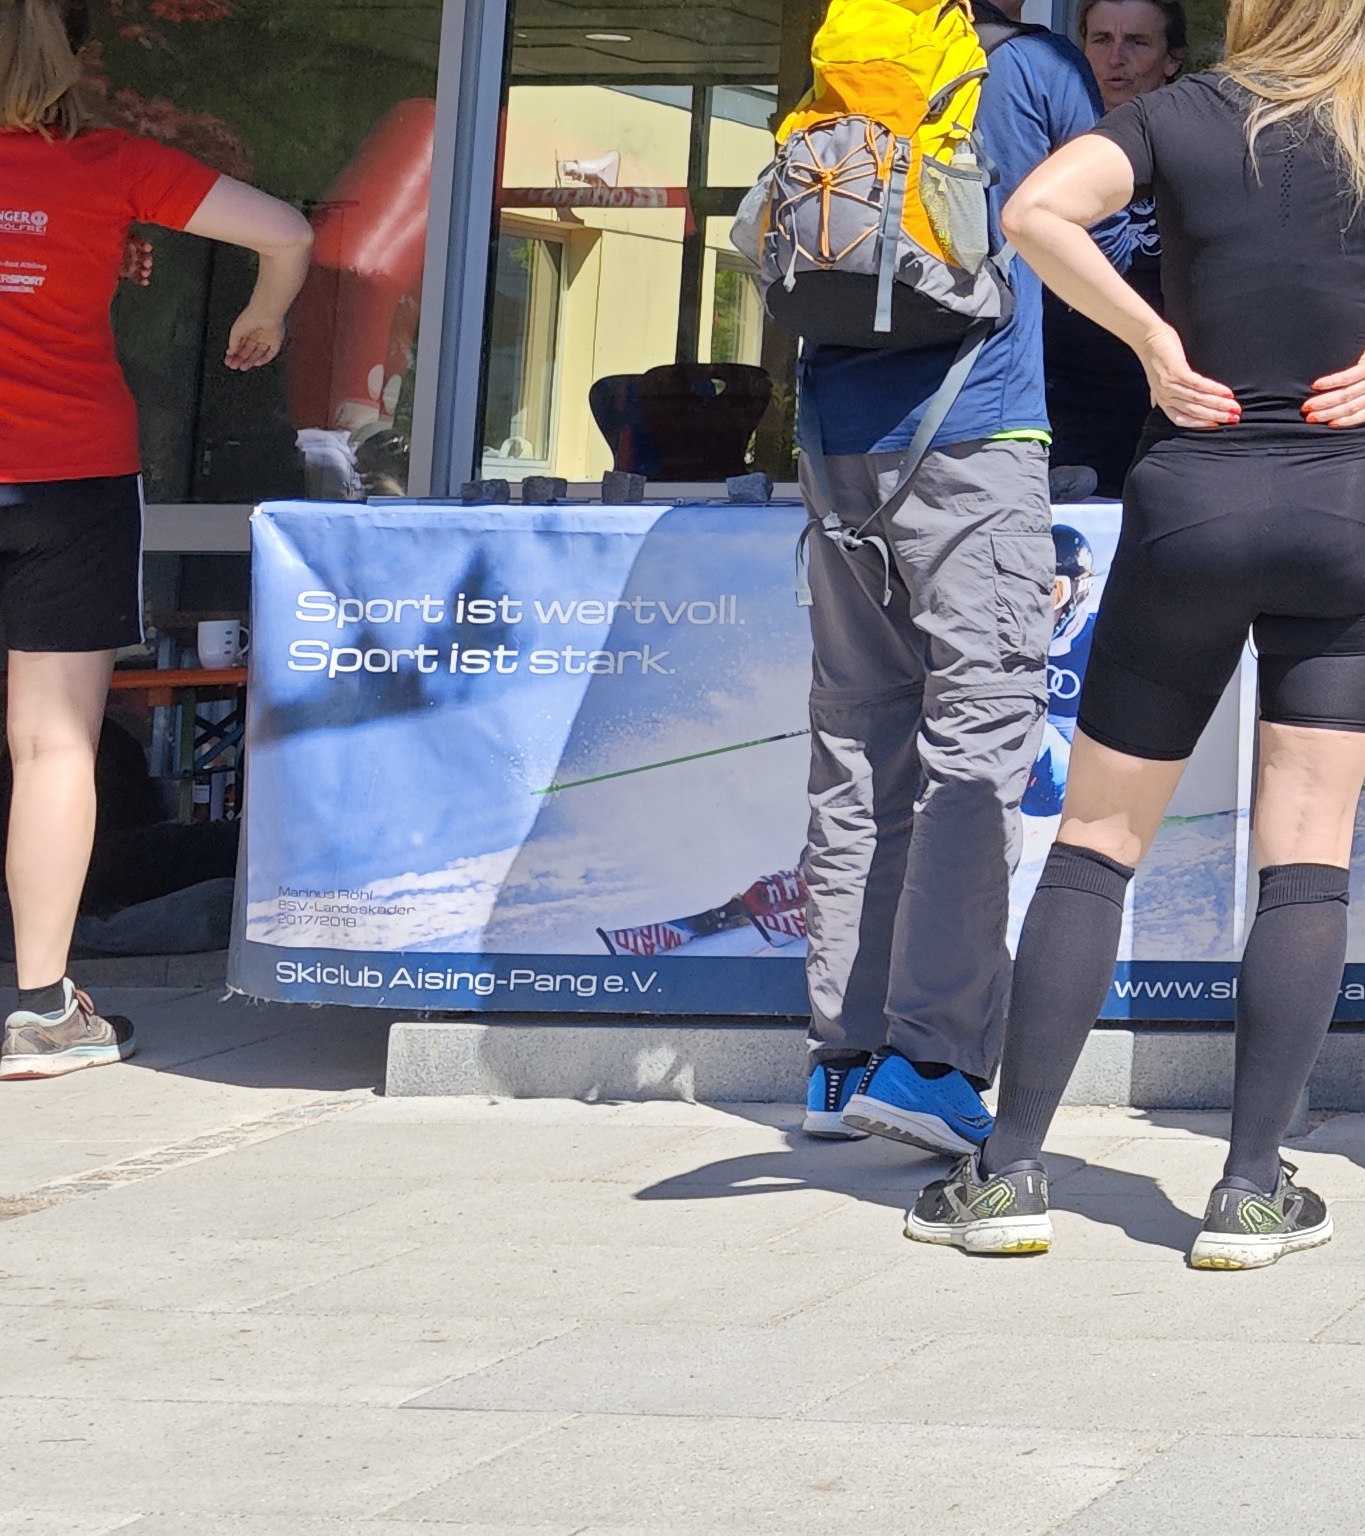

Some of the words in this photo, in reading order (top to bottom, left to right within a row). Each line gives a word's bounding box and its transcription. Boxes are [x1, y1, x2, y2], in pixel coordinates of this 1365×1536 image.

[296, 590, 444, 631] Sport
[456, 593, 523, 625] ist
[534, 593, 747, 626] wertvoll.
[287, 640, 439, 679] Sport
[449, 642, 518, 675] ist
[528, 642, 677, 676] stark.
[278, 886, 335, 900] Marinus
[277, 900, 417, 916] BSV-Landeskader
[277, 914, 357, 928] 2017/2018
[275, 960, 383, 989] Skiclub
[388, 966, 597, 1000] Aising-Pang
[602, 971, 663, 994] e.V.
